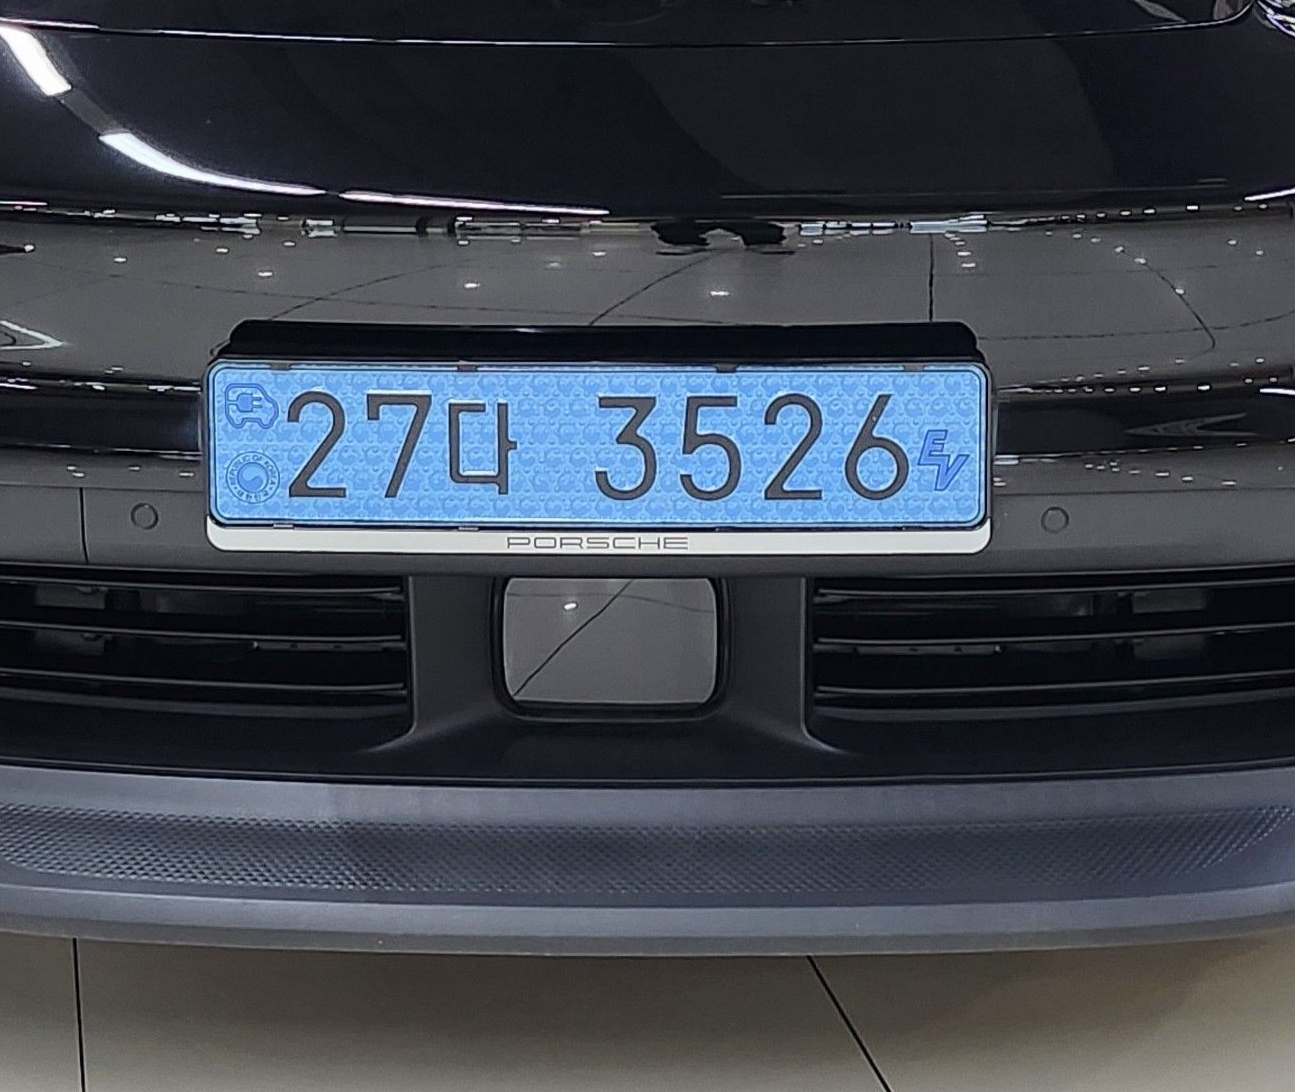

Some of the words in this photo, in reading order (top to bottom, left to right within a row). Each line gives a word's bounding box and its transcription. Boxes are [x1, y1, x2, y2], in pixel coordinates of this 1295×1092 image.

[287, 390, 517, 498] 27다
[595, 393, 910, 500] 3526
[917, 429, 970, 491] EV
[507, 536, 688, 550] PORSCHE
